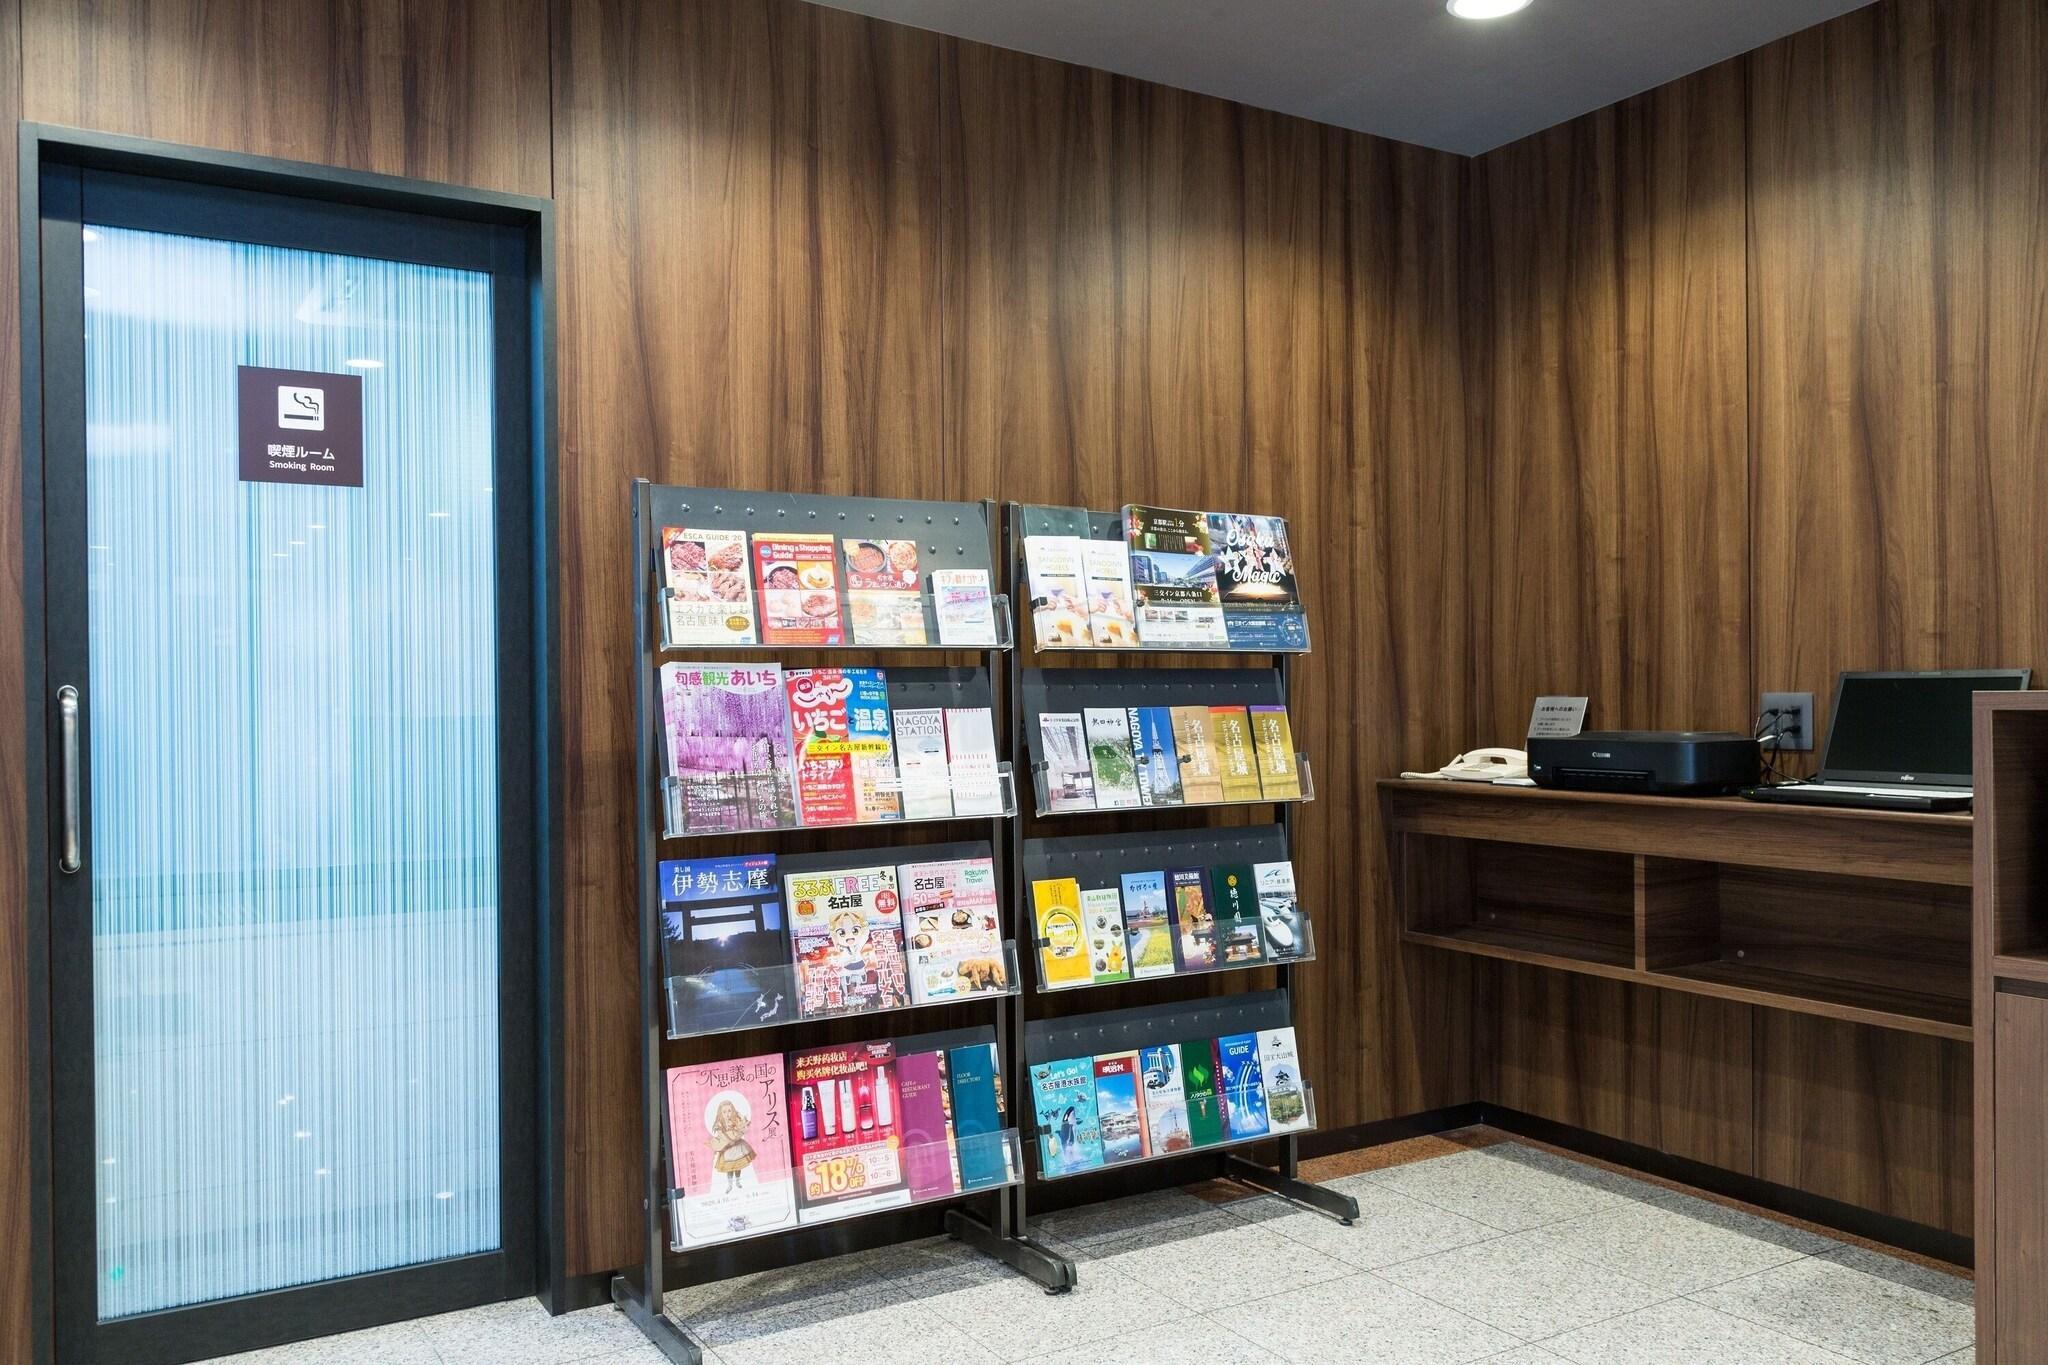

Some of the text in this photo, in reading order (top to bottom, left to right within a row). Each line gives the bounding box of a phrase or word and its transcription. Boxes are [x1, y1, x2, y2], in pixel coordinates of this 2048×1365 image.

[268, 444, 335, 460] 喫煙ルーム
[269, 461, 335, 472] Smoking Room
[1226, 527, 1275, 547] Osaka
[772, 544, 795, 552] Dining
[799, 544, 832, 553] Shopping
[773, 552, 793, 560] Guide
[1232, 566, 1282, 585] Magic
[675, 669, 777, 687] 旬感観光あいち
[792, 707, 847, 732] いちご
[853, 707, 889, 732] 温泉
[896, 715, 941, 726] NAGOYA
[897, 726, 942, 736] STATION
[1127, 707, 1144, 751] NAGOYA
[1138, 768, 1153, 806] TOWE
[802, 769, 834, 780] ドライブ
[964, 868, 989, 877] Rakuten
[671, 867, 769, 897] 伊勢志摩
[914, 876, 945, 890] 名古屋
[828, 894, 863, 909] 名古屋
[825, 963, 844, 1008] 大特集
[1229, 1045, 1250, 1056] GUIDE
[697, 1063, 777, 1088] 不思議の国の
[1049, 1067, 1078, 1079] Let's Go!
[759, 1078, 781, 1140] アリス展
[814, 1156, 865, 1195] 18%
[848, 1174, 866, 1189] OFF
